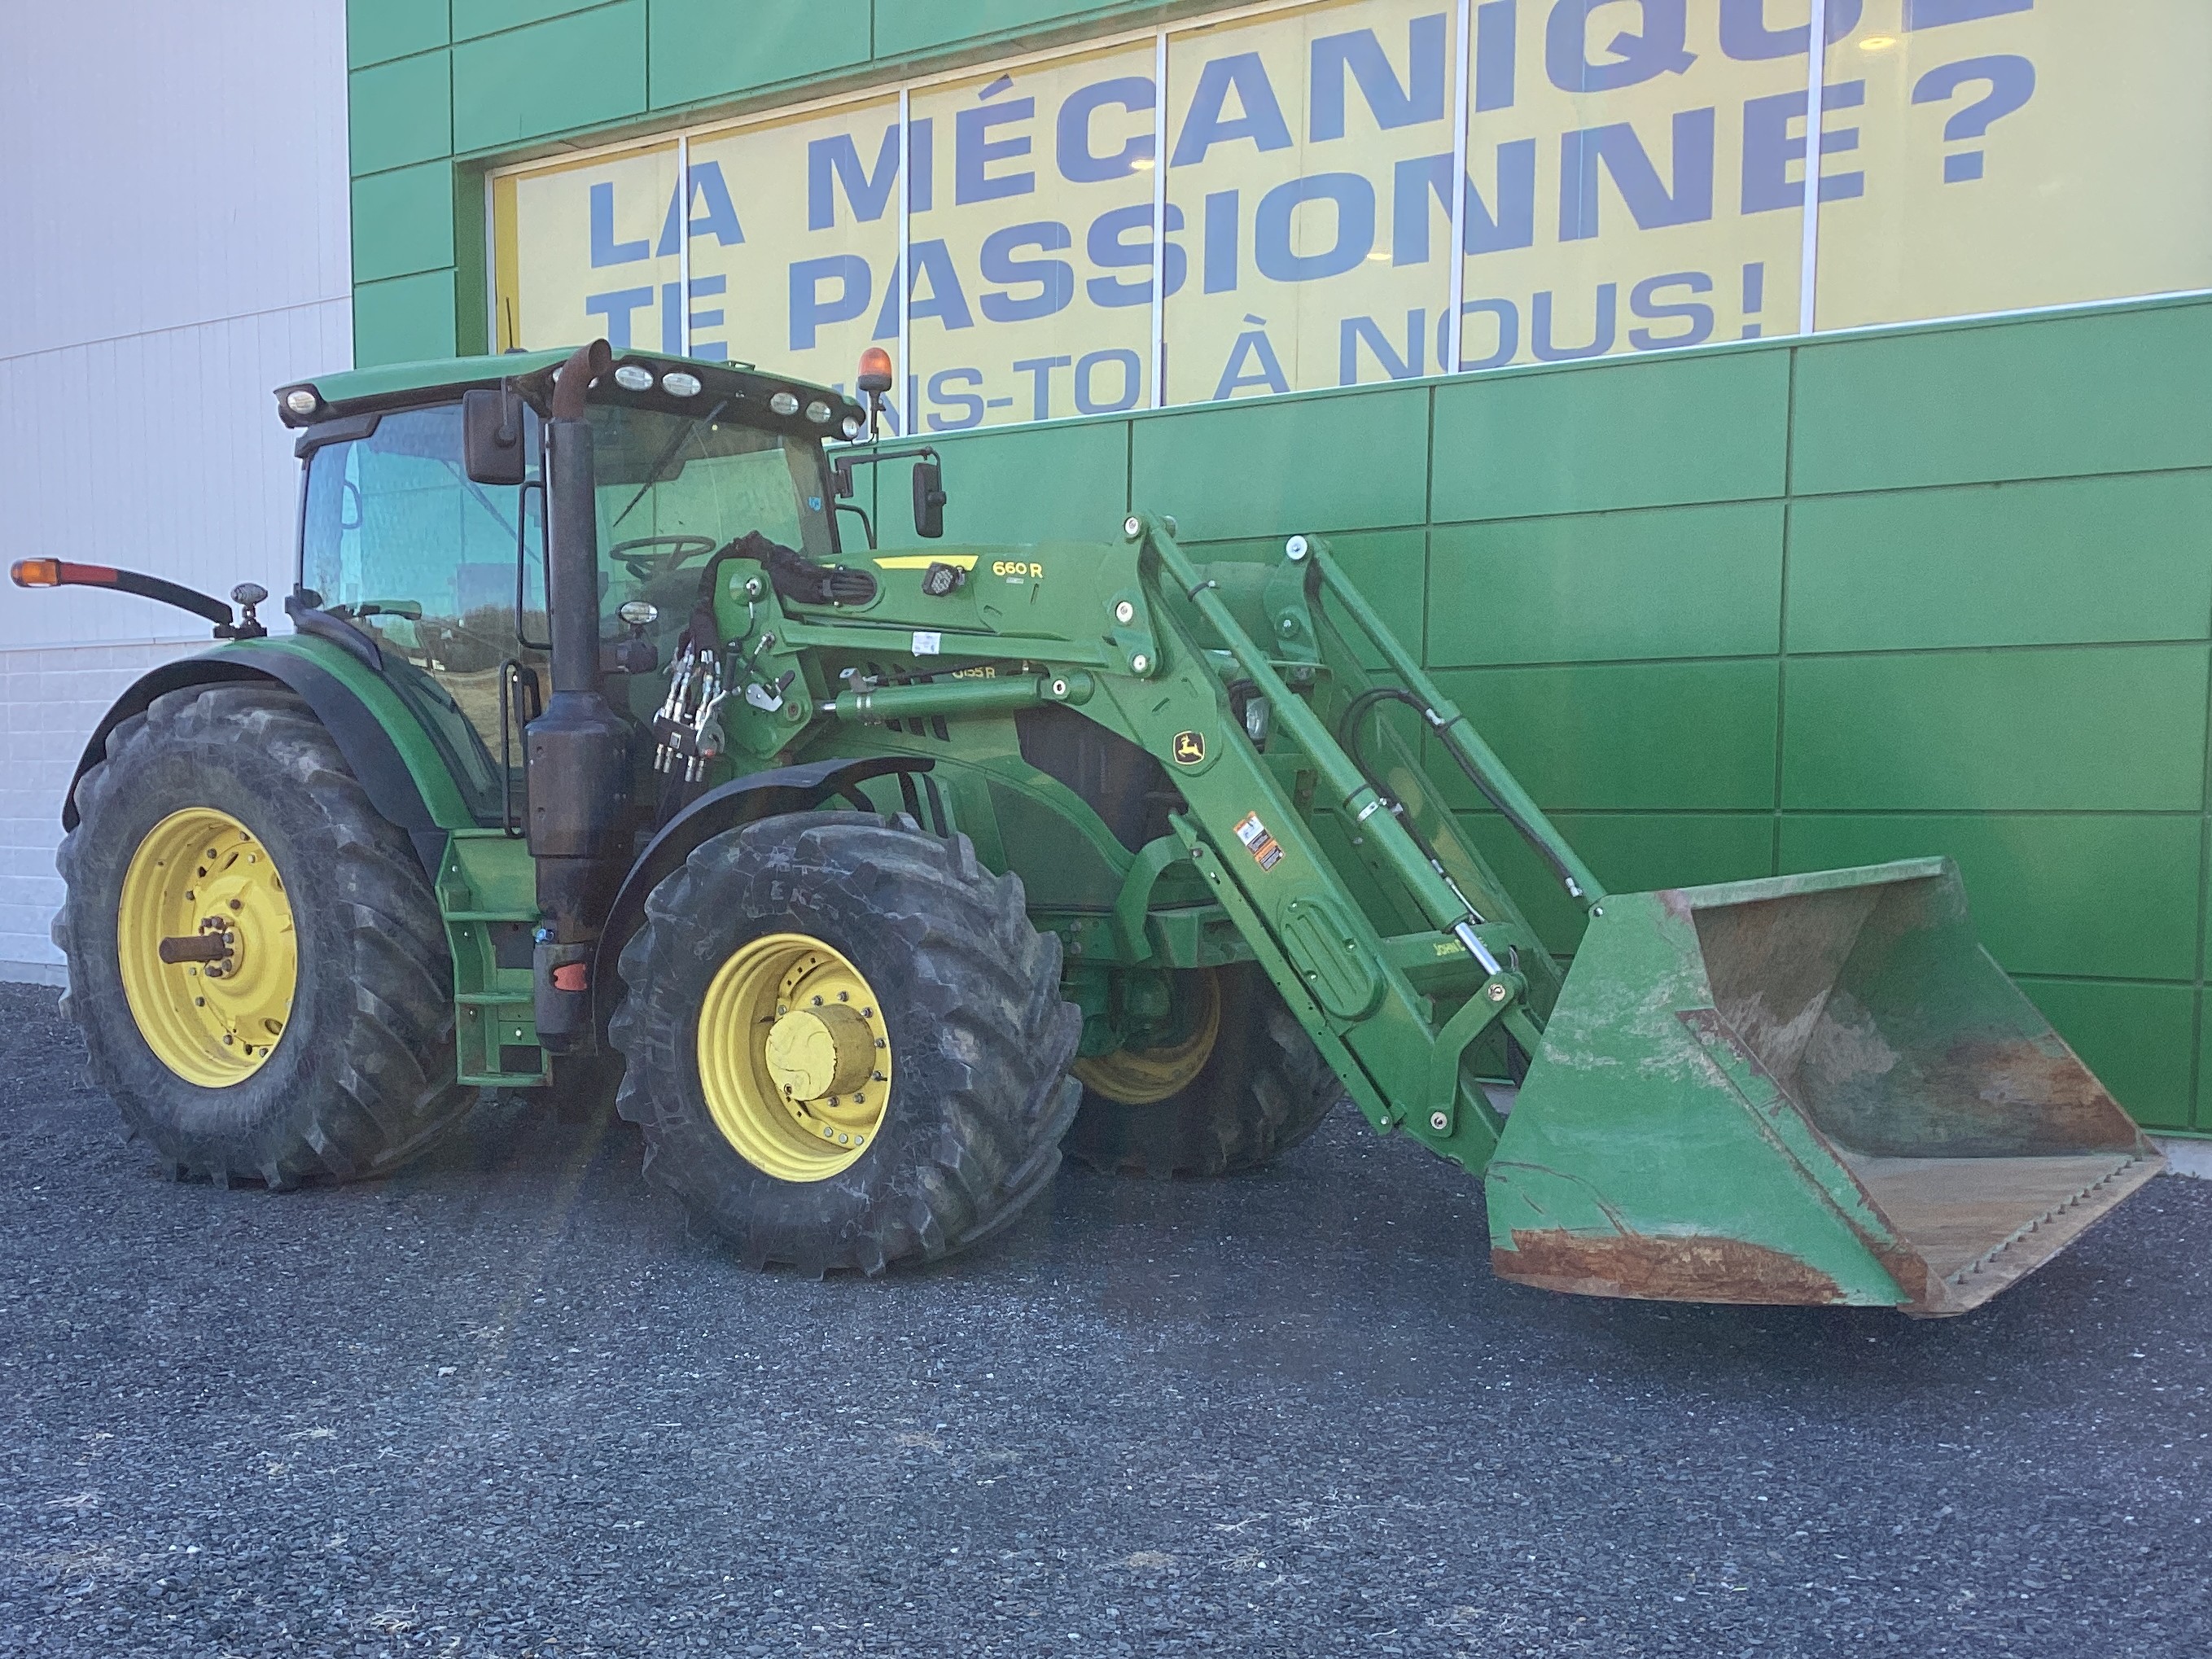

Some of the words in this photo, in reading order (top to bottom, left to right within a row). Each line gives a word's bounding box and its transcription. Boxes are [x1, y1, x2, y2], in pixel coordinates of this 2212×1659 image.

[589, 160, 746, 268] LA
[808, 0, 2034, 230] MÉCANIQ
[585, 274, 727, 361] TE
[1213, 313, 1290, 401] À
[1339, 262, 1763, 385] NOUS!
